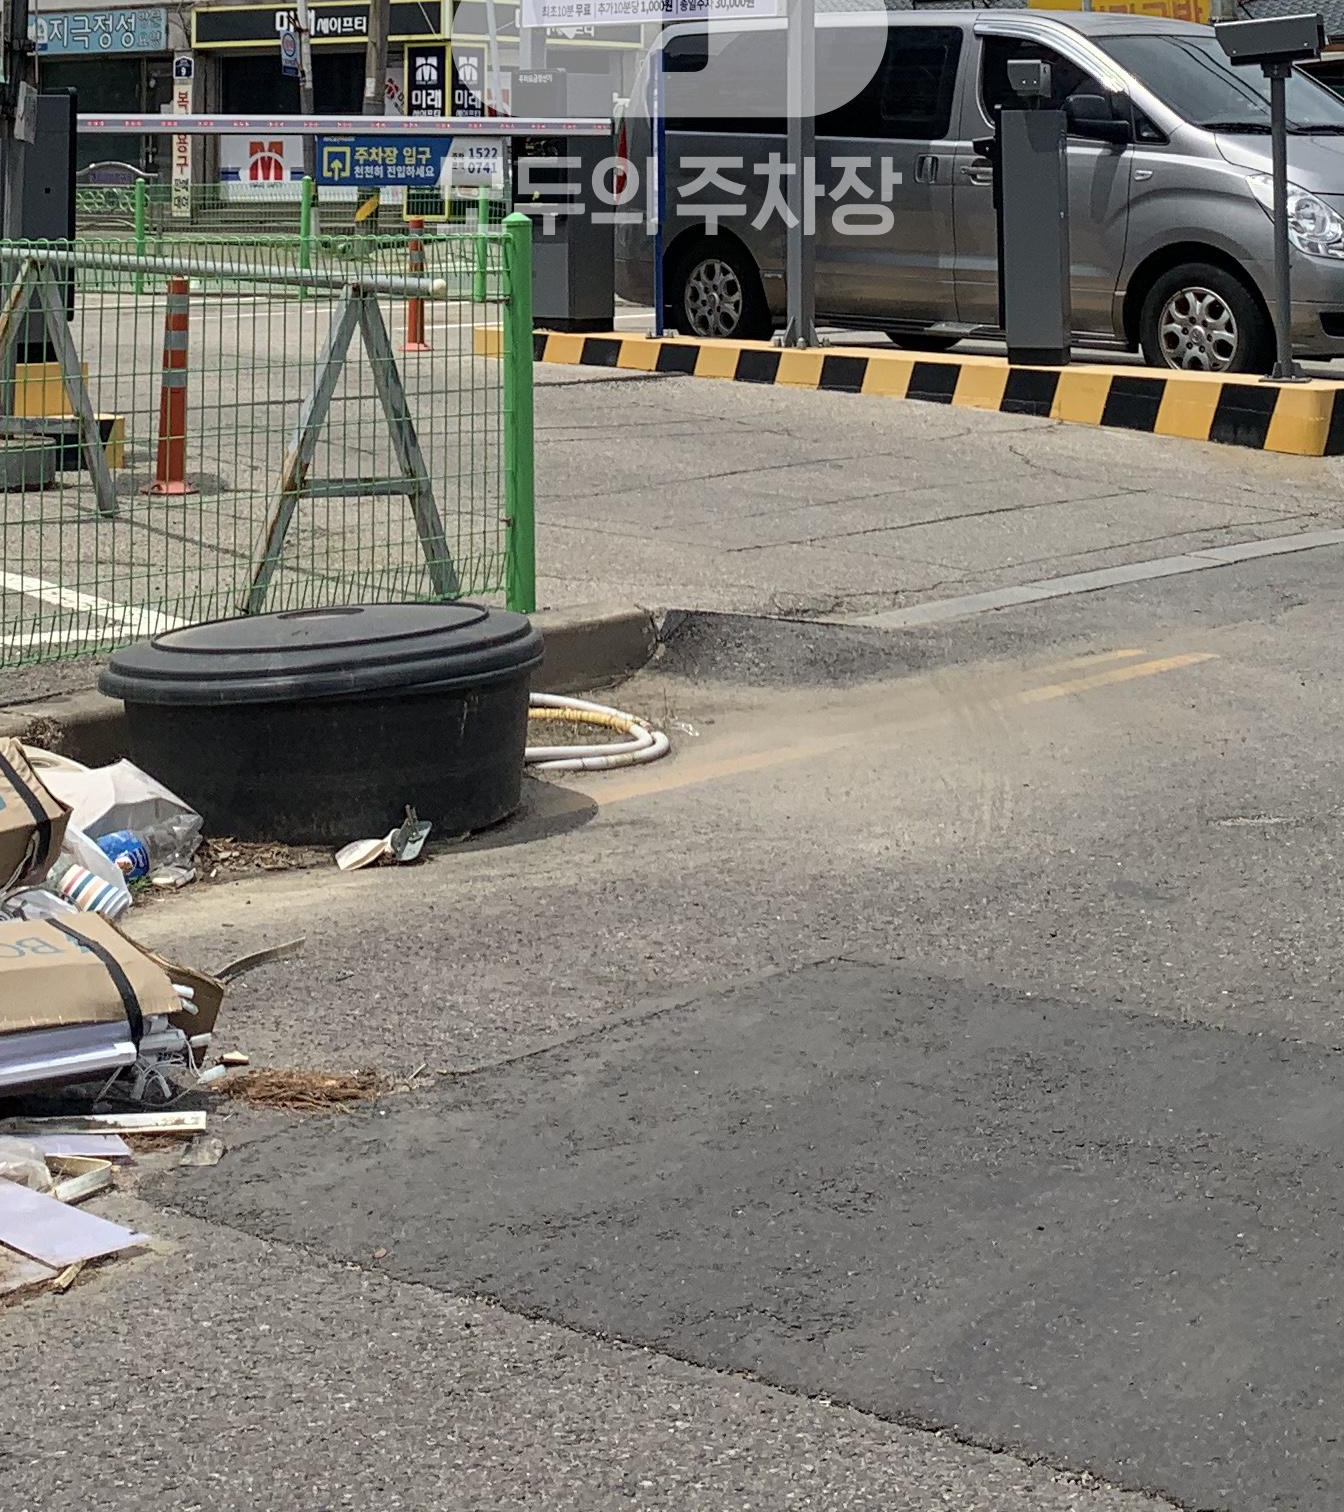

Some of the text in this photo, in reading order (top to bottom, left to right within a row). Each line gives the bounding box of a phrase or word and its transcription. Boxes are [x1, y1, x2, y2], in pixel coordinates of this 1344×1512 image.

[575, 3, 592, 17] 무료
[49, 10, 136, 49] 지극정성
[316, 16, 367, 34] 세이프티
[411, 88, 443, 109] 미래
[455, 88, 483, 109] 미래
[354, 146, 398, 165] 주차장
[402, 146, 432, 165] 입구
[468, 146, 498, 160] 1522
[354, 164, 435, 179] 천천히 진입하세요
[467, 161, 497, 175] 0741
